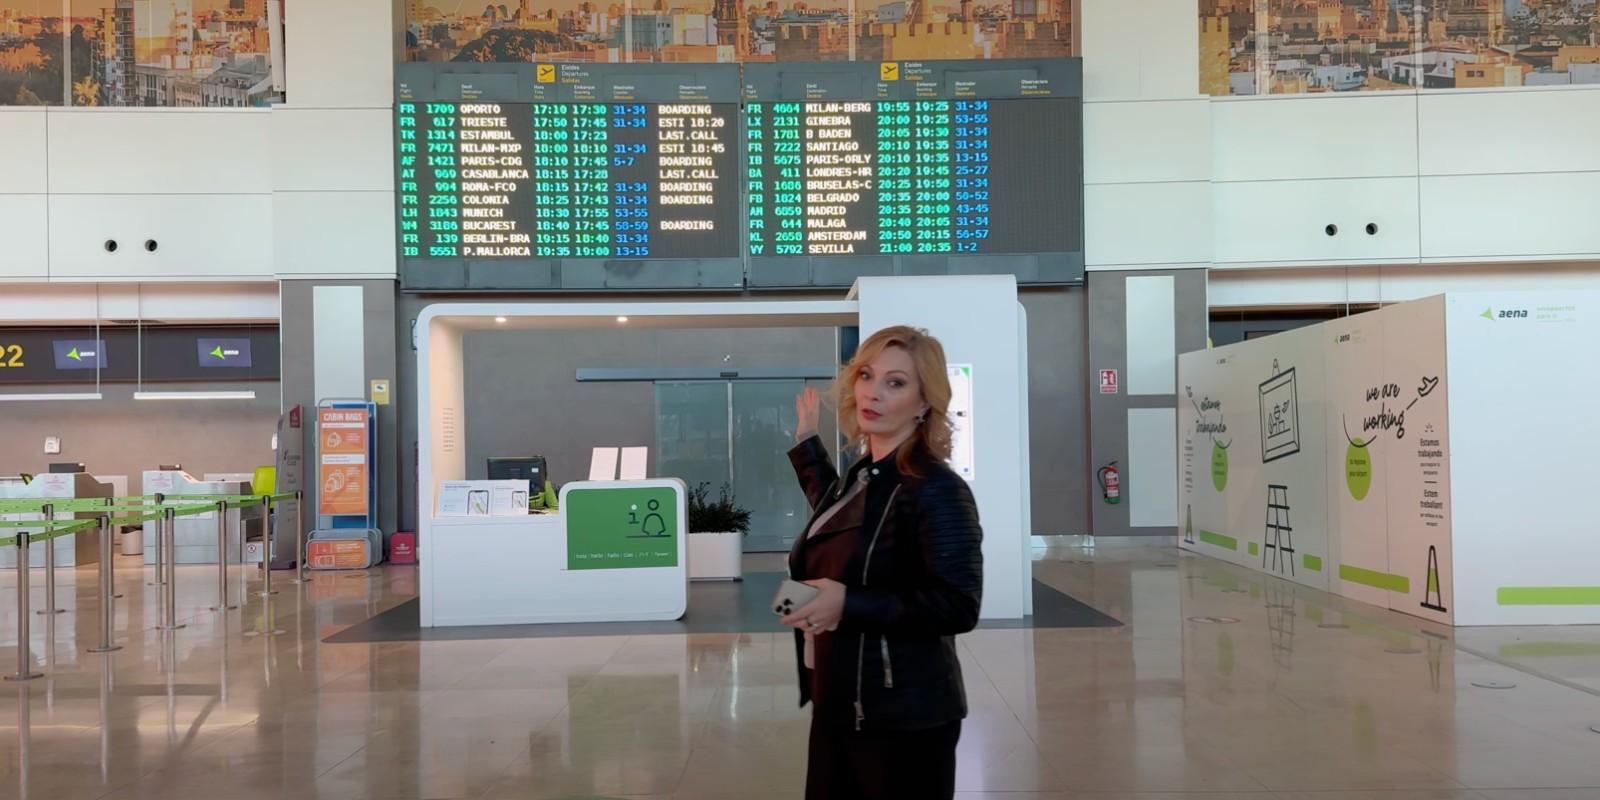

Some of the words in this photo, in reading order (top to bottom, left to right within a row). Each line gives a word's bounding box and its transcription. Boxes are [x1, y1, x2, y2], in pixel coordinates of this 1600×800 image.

[399, 104, 415, 113] FR
[460, 104, 501, 114] OPORTO
[534, 105, 567, 114] 17:10
[573, 105, 607, 115] 17:30
[614, 105, 645, 114] 31-34
[658, 105, 711, 114] BOARDING
[747, 104, 762, 113] FR
[806, 103, 871, 113] MILAN-BERG
[877, 102, 910, 112] 19:55
[916, 101, 949, 111] 19:25
[956, 101, 987, 111] 31-34
[399, 116, 415, 126] FR
[461, 117, 507, 127] TRIESTE
[534, 117, 567, 127] 17:50
[573, 117, 607, 127] 17:45
[614, 118, 646, 127] 31-34
[659, 117, 684, 128] ESTI
[691, 117, 724, 128] 18:20
[747, 117, 761, 126] LX
[773, 116, 799, 126] 2131
[806, 115, 851, 126] GINEBRA
[916, 114, 949, 124] 19:25
[955, 114, 987, 123] 53-55
[401, 130, 415, 139] TK
[427, 130, 455, 140] 1314
[460, 130, 514, 140] ESTAMBUL
[573, 131, 607, 140] 17:23
[659, 130, 718, 140] LAST.CALL
[748, 130, 762, 139] FR
[806, 128, 813, 139] B
[819, 128, 852, 139] BADEN
[878, 128, 910, 138] 20:05
[916, 127, 949, 137] 19:30
[956, 127, 987, 136] 31-34
[400, 142, 416, 152] FR
[428, 143, 455, 153] 7471
[461, 143, 521, 153] MILAN-MXP
[574, 144, 607, 153] 18:10
[615, 144, 646, 153] 31-34
[659, 143, 685, 153] ESTI
[691, 143, 725, 153] 18:45
[748, 142, 762, 152] FR
[774, 142, 800, 152] 7222
[806, 141, 859, 152] SANTIAGO
[878, 141, 910, 151] 20:10
[916, 140, 949, 150] 19:35
[956, 140, 987, 149] 31-34
[400, 156, 415, 165] AF
[428, 156, 455, 166] 1421
[461, 156, 522, 166] PARIS-CDG
[535, 156, 568, 166] 18:10
[574, 156, 608, 166] 17:45
[614, 157, 634, 166] 5-7
[659, 156, 712, 166] BOARDING
[749, 155, 762, 165] IB
[806, 154, 871, 165] PARIS-ORLY
[878, 153, 910, 163] 20:10
[916, 153, 949, 163] 19:35
[956, 153, 988, 162] 13-15
[400, 169, 415, 178] AT
[461, 169, 529, 179] CASABLANCA
[536, 169, 568, 179] 18:15
[574, 169, 608, 179] 17:28
[660, 169, 719, 179] LAST.CALL
[781, 168, 800, 178] 411
[806, 167, 872, 177] LONDRES-HR
[878, 166, 911, 176] 20:20
[916, 165, 949, 175] 19:45
[956, 165, 987, 175] 25-27
[401, 181, 417, 191] FR
[462, 182, 516, 192] ROMA-FCO
[536, 182, 569, 192] 18:15
[575, 182, 608, 192] 17:42
[616, 183, 647, 191] 31-34
[660, 182, 713, 192] BOARDING
[748, 181, 763, 191] FR
[807, 180, 872, 190] BRUSELAS-C
[878, 179, 911, 189] 20:25
[916, 178, 950, 189] 19:50
[957, 179, 987, 187] 31-34
[401, 195, 418, 204] FR
[462, 195, 509, 205] COLONIA
[536, 195, 569, 205] 18:25
[575, 195, 609, 205] 17:43
[616, 196, 647, 204] 31-34
[660, 194, 713, 204] BOARDING
[807, 192, 860, 203] BELGRADO
[878, 192, 911, 202] 20:35
[401, 208, 418, 217] LH
[462, 208, 503, 218] MUNICH
[536, 208, 569, 218] 18:30
[575, 208, 609, 217] 17:55
[615, 209, 648, 217] 53-55
[807, 205, 846, 216] MADRID
[879, 204, 911, 215] 20:35
[956, 204, 988, 213] 43-45
[463, 221, 516, 230] BUCAREST
[537, 221, 570, 230] 18:40
[575, 221, 609, 230] 17:45
[660, 220, 714, 230] BOARDING
[748, 219, 764, 229] FR
[781, 219, 802, 228] 644
[807, 218, 846, 228] MALAGA
[879, 217, 911, 227] 20:40
[916, 217, 950, 227] 20:05
[957, 217, 988, 225] 31-34
[403, 234, 418, 243] FR
[436, 234, 458, 243] 139
[463, 234, 530, 243] BERLIN-BRA
[537, 234, 570, 243] 19:15
[576, 234, 609, 243] 18:40
[616, 234, 648, 243] 31-34
[749, 232, 763, 241] KL
[808, 231, 866, 241] AMSTERDAM
[879, 230, 912, 240] 20:50
[917, 229, 950, 239] 20:15
[404, 247, 418, 256] IB
[463, 246, 530, 256] P.MALLORCA
[537, 247, 570, 256] 19:35
[616, 247, 648, 255] 13-15
[750, 245, 763, 254] VY
[808, 244, 854, 253] SEVILLA
[918, 242, 951, 252] 20:35
[958, 243, 976, 251] 1-2
[1498, 309, 1529, 318] aena
[1365, 386, 1380, 402] we
[1382, 381, 1400, 399] are
[1363, 402, 1405, 439] working
